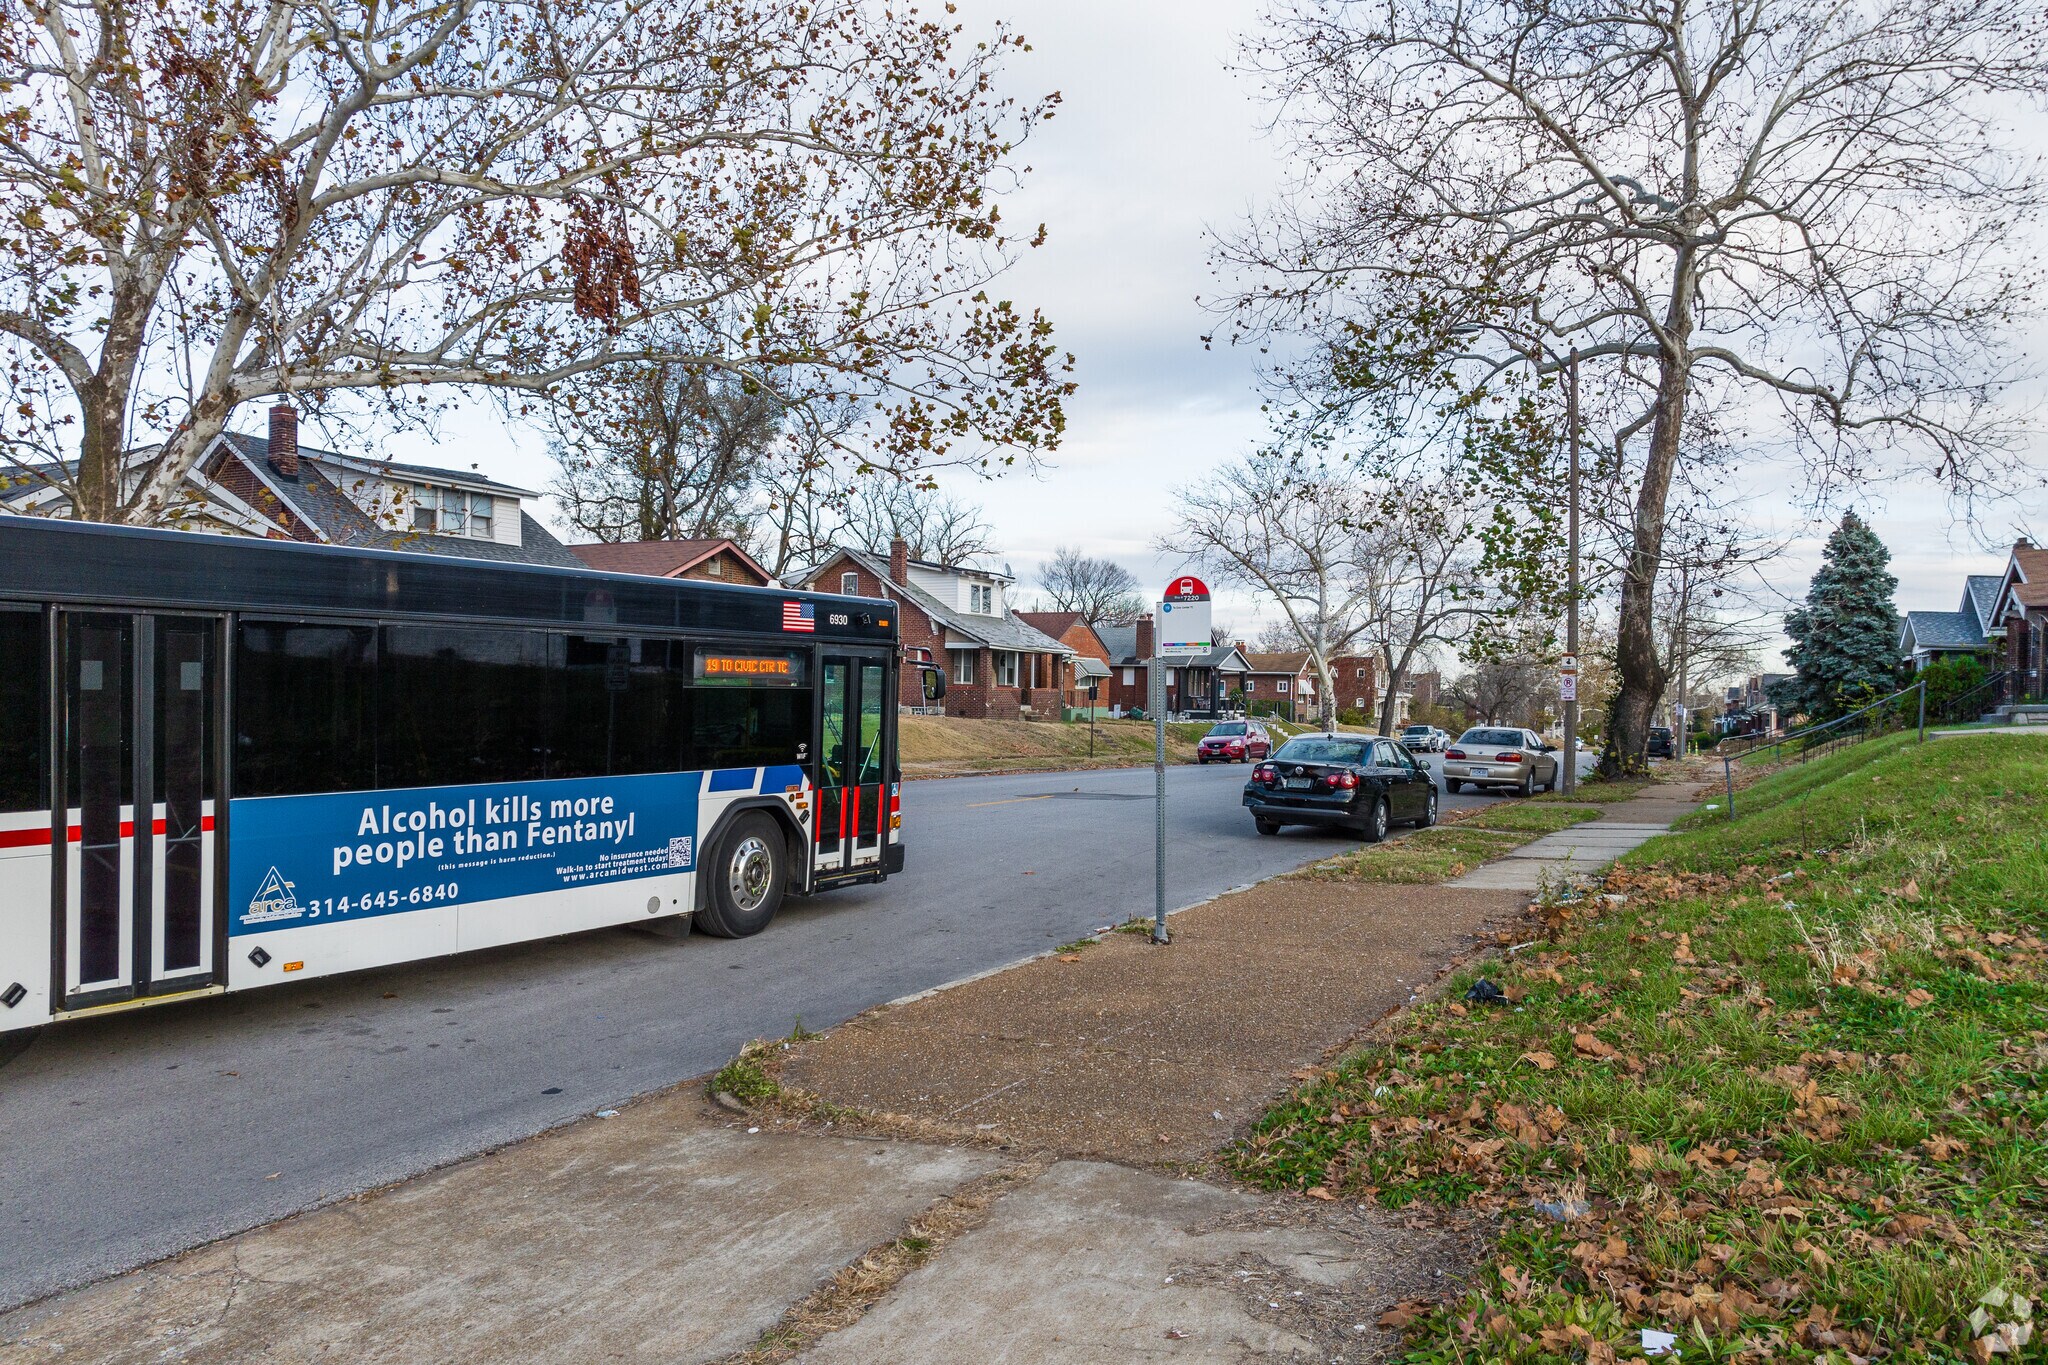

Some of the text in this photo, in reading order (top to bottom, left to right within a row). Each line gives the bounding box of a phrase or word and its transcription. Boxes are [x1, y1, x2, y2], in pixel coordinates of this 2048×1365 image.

[829, 614, 848, 625] 6930
[706, 658, 789, 673] 19 TO CIVIC CTR TC
[357, 795, 614, 836] Alcohol kills more
[333, 811, 635, 876] people than Fentanyl
[437, 863, 456, 872] (this
[458, 859, 488, 868] message
[518, 852, 556, 861] reduction.)
[585, 863, 593, 871] to
[594, 862, 612, 870] start
[612, 858, 647, 867] treatment
[647, 855, 669, 865] today!
[599, 847, 669, 862] No insurance needed
[563, 862, 668, 883] www.arcamidwest.com
[249, 897, 298, 915] arca
[308, 882, 459, 918] 314-645-6840
